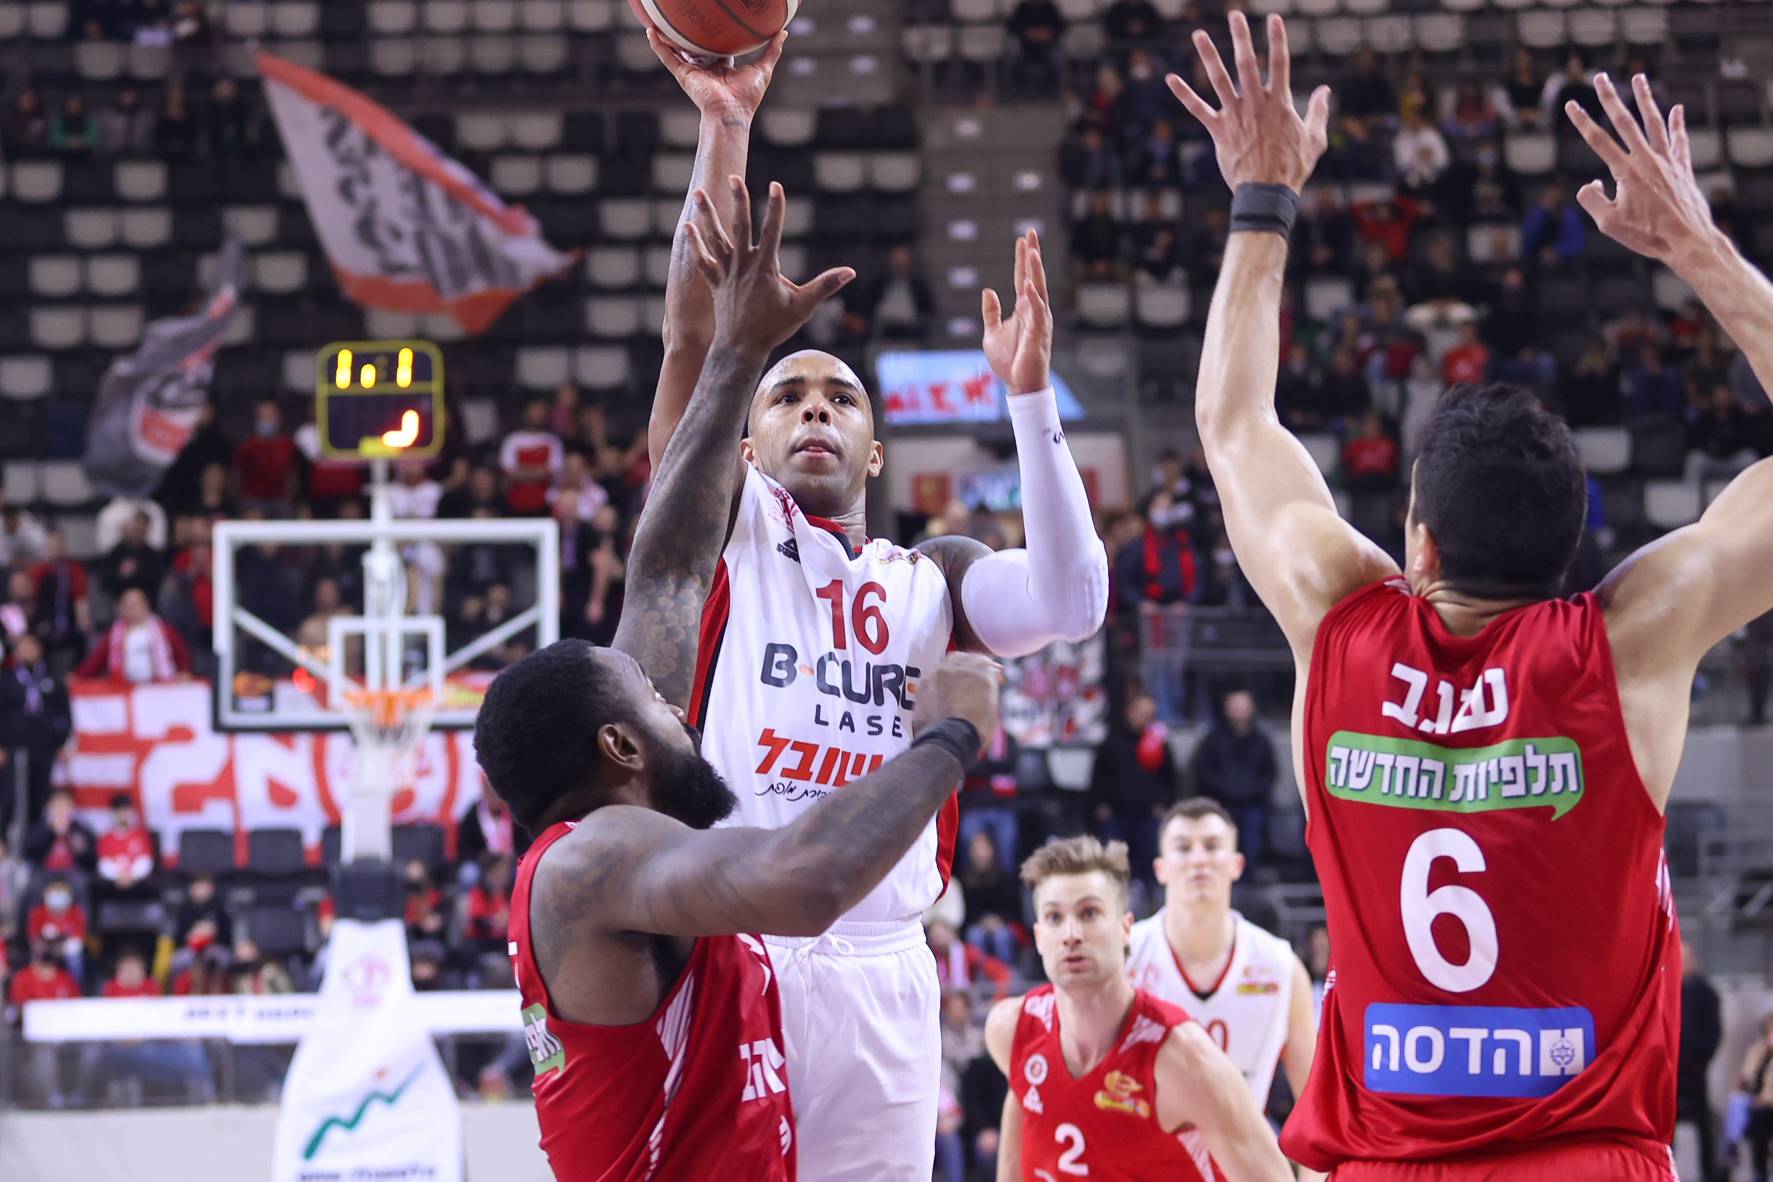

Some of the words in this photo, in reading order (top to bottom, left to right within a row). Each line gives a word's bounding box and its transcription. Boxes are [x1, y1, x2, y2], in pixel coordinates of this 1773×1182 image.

[815, 579, 890, 655] 16
[760, 642, 921, 711] B-CURE
[1381, 661, 1510, 735] שגב
[814, 704, 903, 738] LASE
[755, 728, 884, 787] שובל
[1329, 745, 1448, 800] החדשה
[1449, 744, 1580, 802] תלפיות
[1400, 827, 1499, 993] 6
[1371, 1024, 1532, 1076] הדסה
[1054, 1122, 1089, 1176] 2
